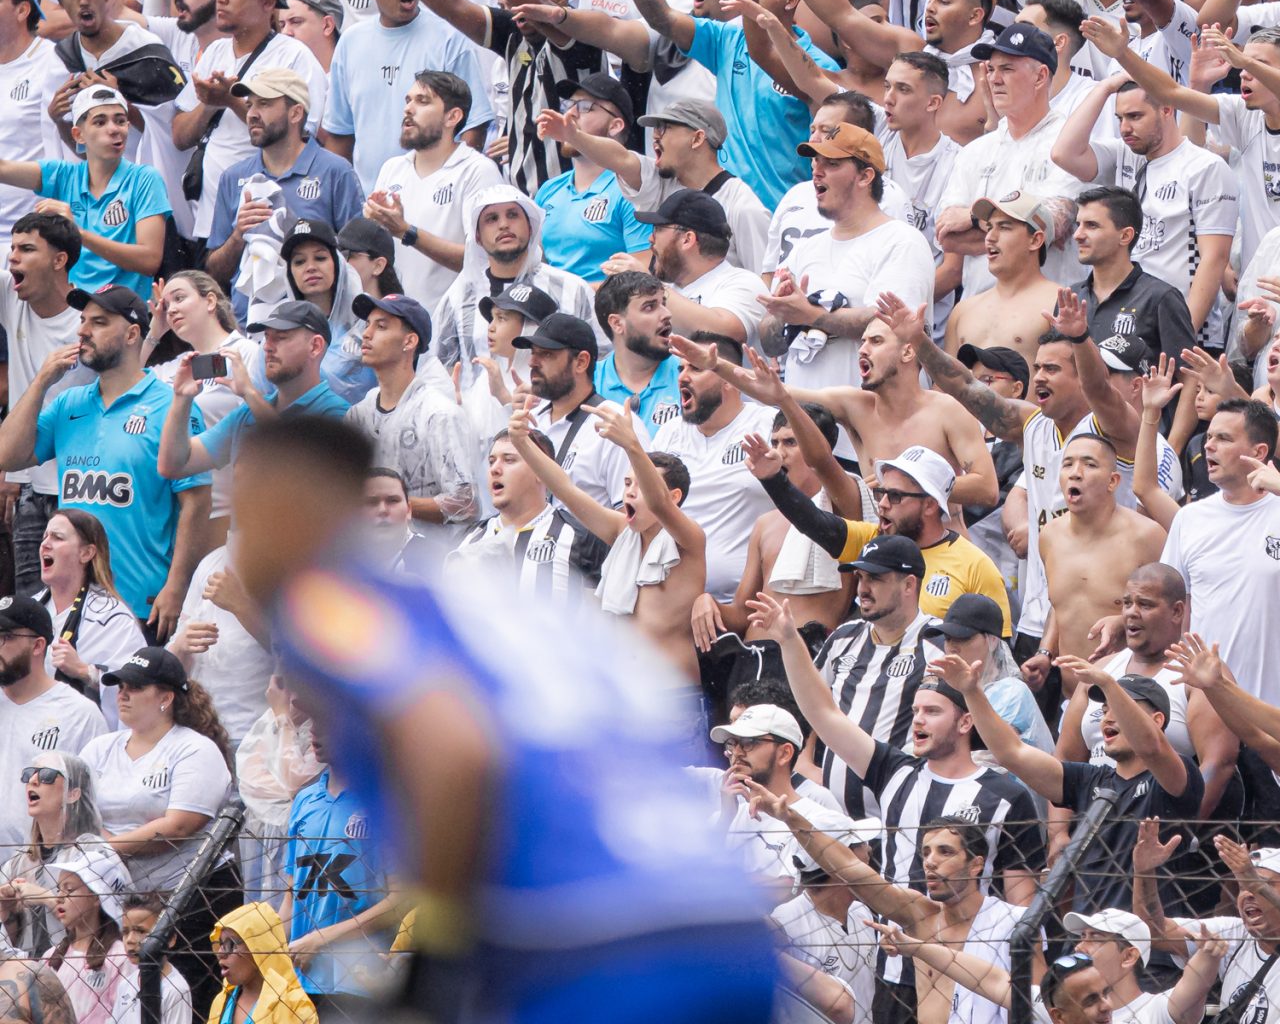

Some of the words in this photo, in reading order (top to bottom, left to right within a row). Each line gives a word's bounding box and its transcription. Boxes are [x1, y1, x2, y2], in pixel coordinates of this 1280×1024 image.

[66, 455, 101, 467] BANCO
[62, 471, 134, 507] BMG
[296, 852, 359, 902] 7K
